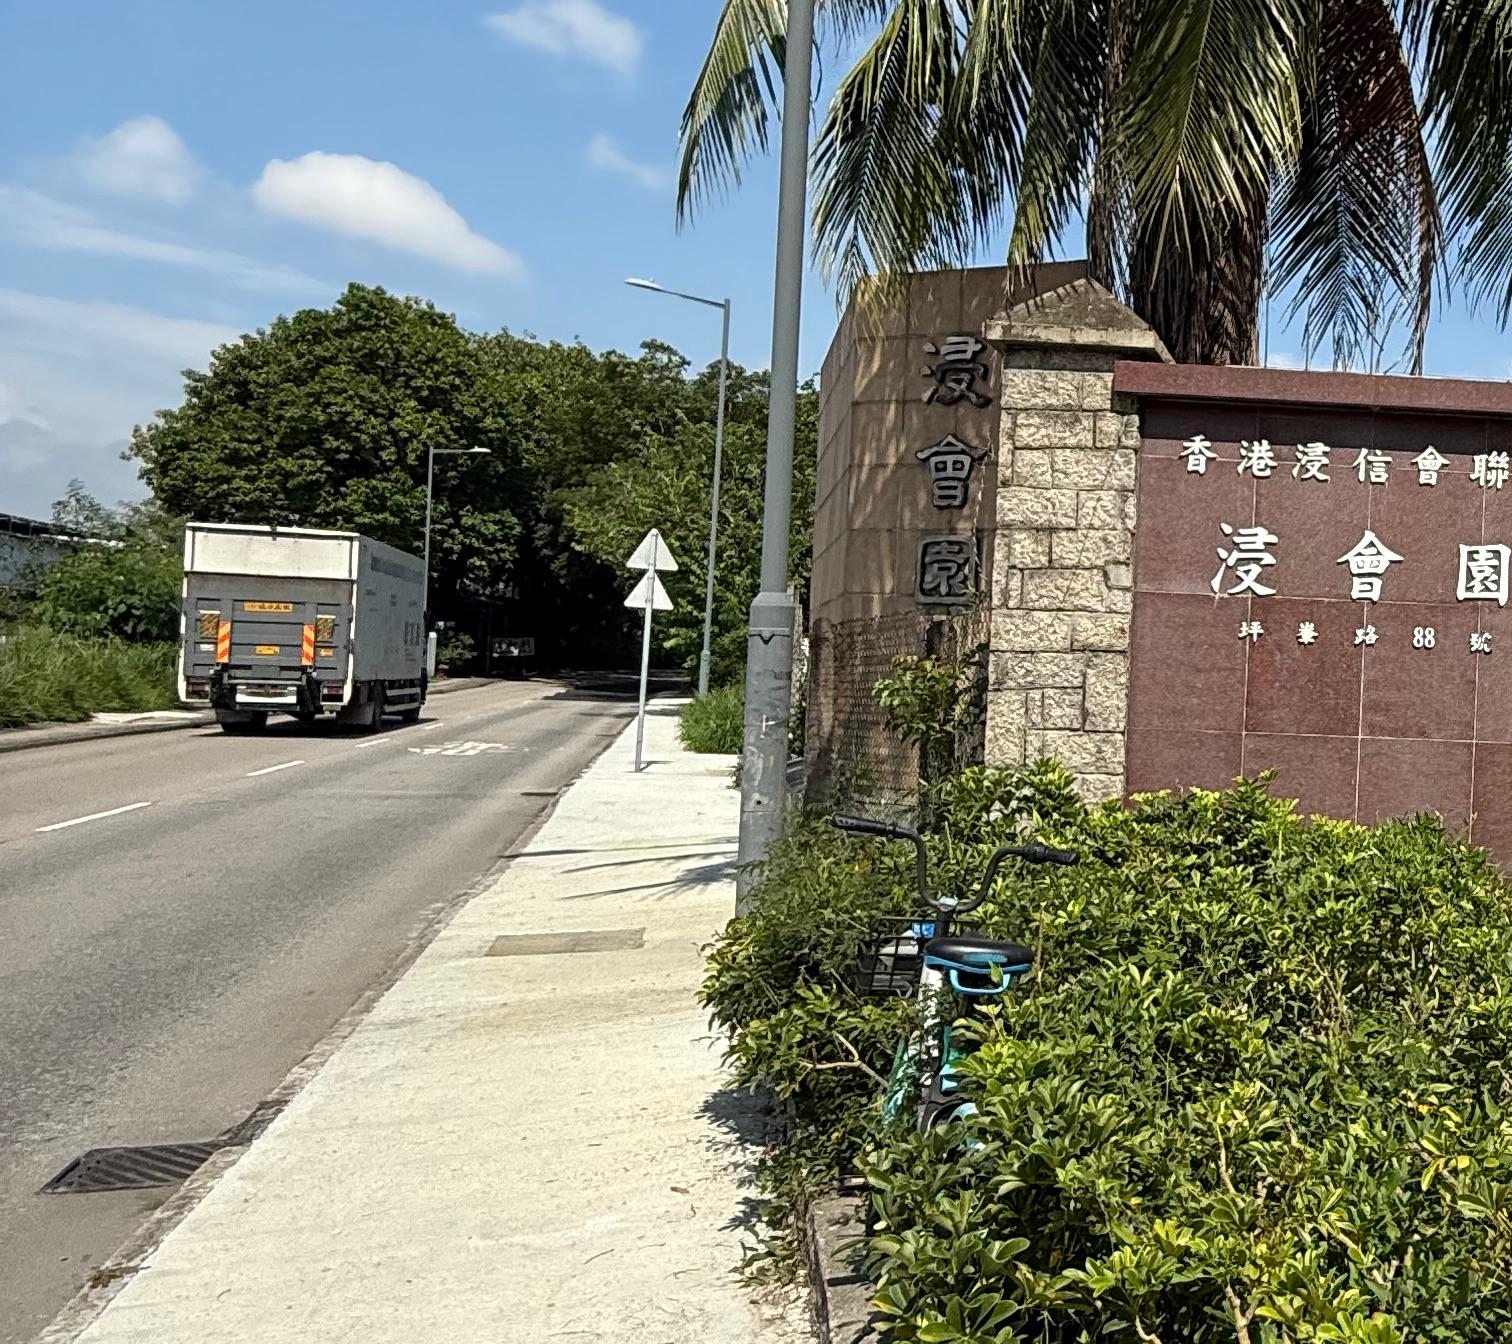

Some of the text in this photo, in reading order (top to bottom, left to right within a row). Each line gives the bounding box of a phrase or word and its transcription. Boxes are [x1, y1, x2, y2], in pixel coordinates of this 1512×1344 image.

[915, 335, 994, 607] 浸會園
[1210, 522, 1512, 607] 浸會園
